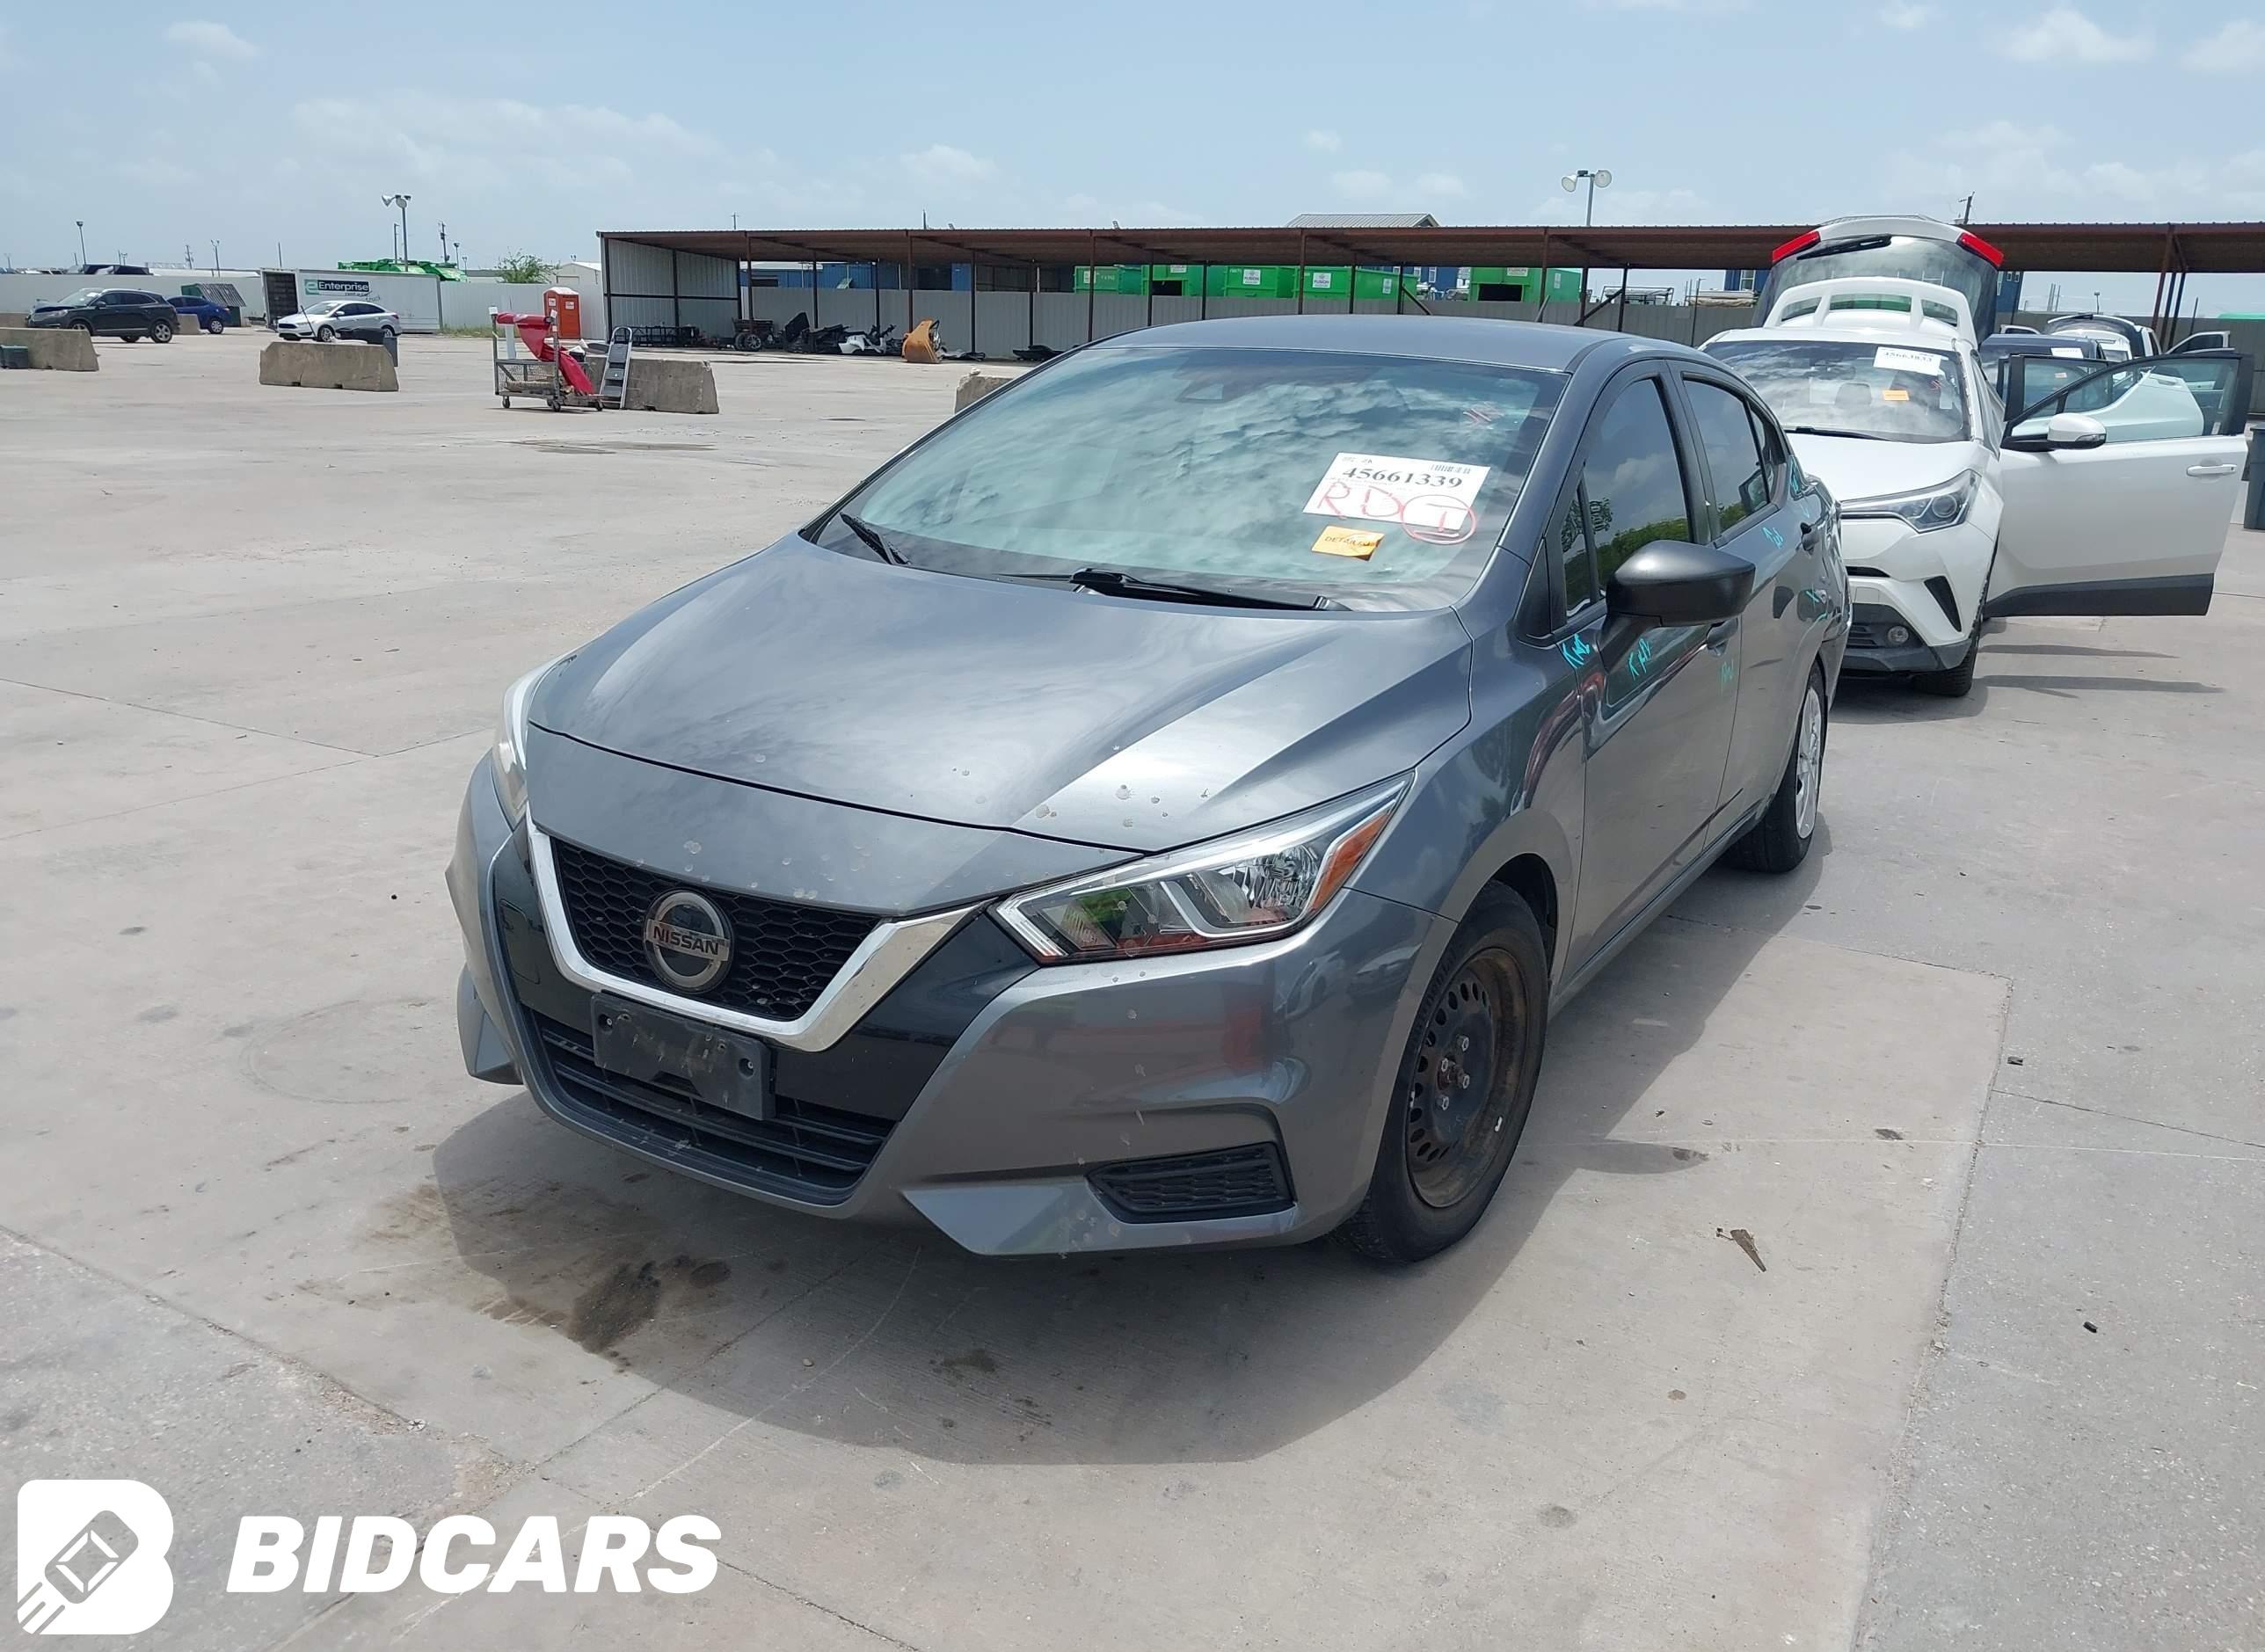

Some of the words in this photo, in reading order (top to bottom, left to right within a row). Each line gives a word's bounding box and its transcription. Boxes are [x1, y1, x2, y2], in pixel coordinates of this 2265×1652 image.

[318, 281, 368, 291] Enterprise
[1343, 467, 1462, 488] 45661339
[653, 925, 719, 956] NISSAN
